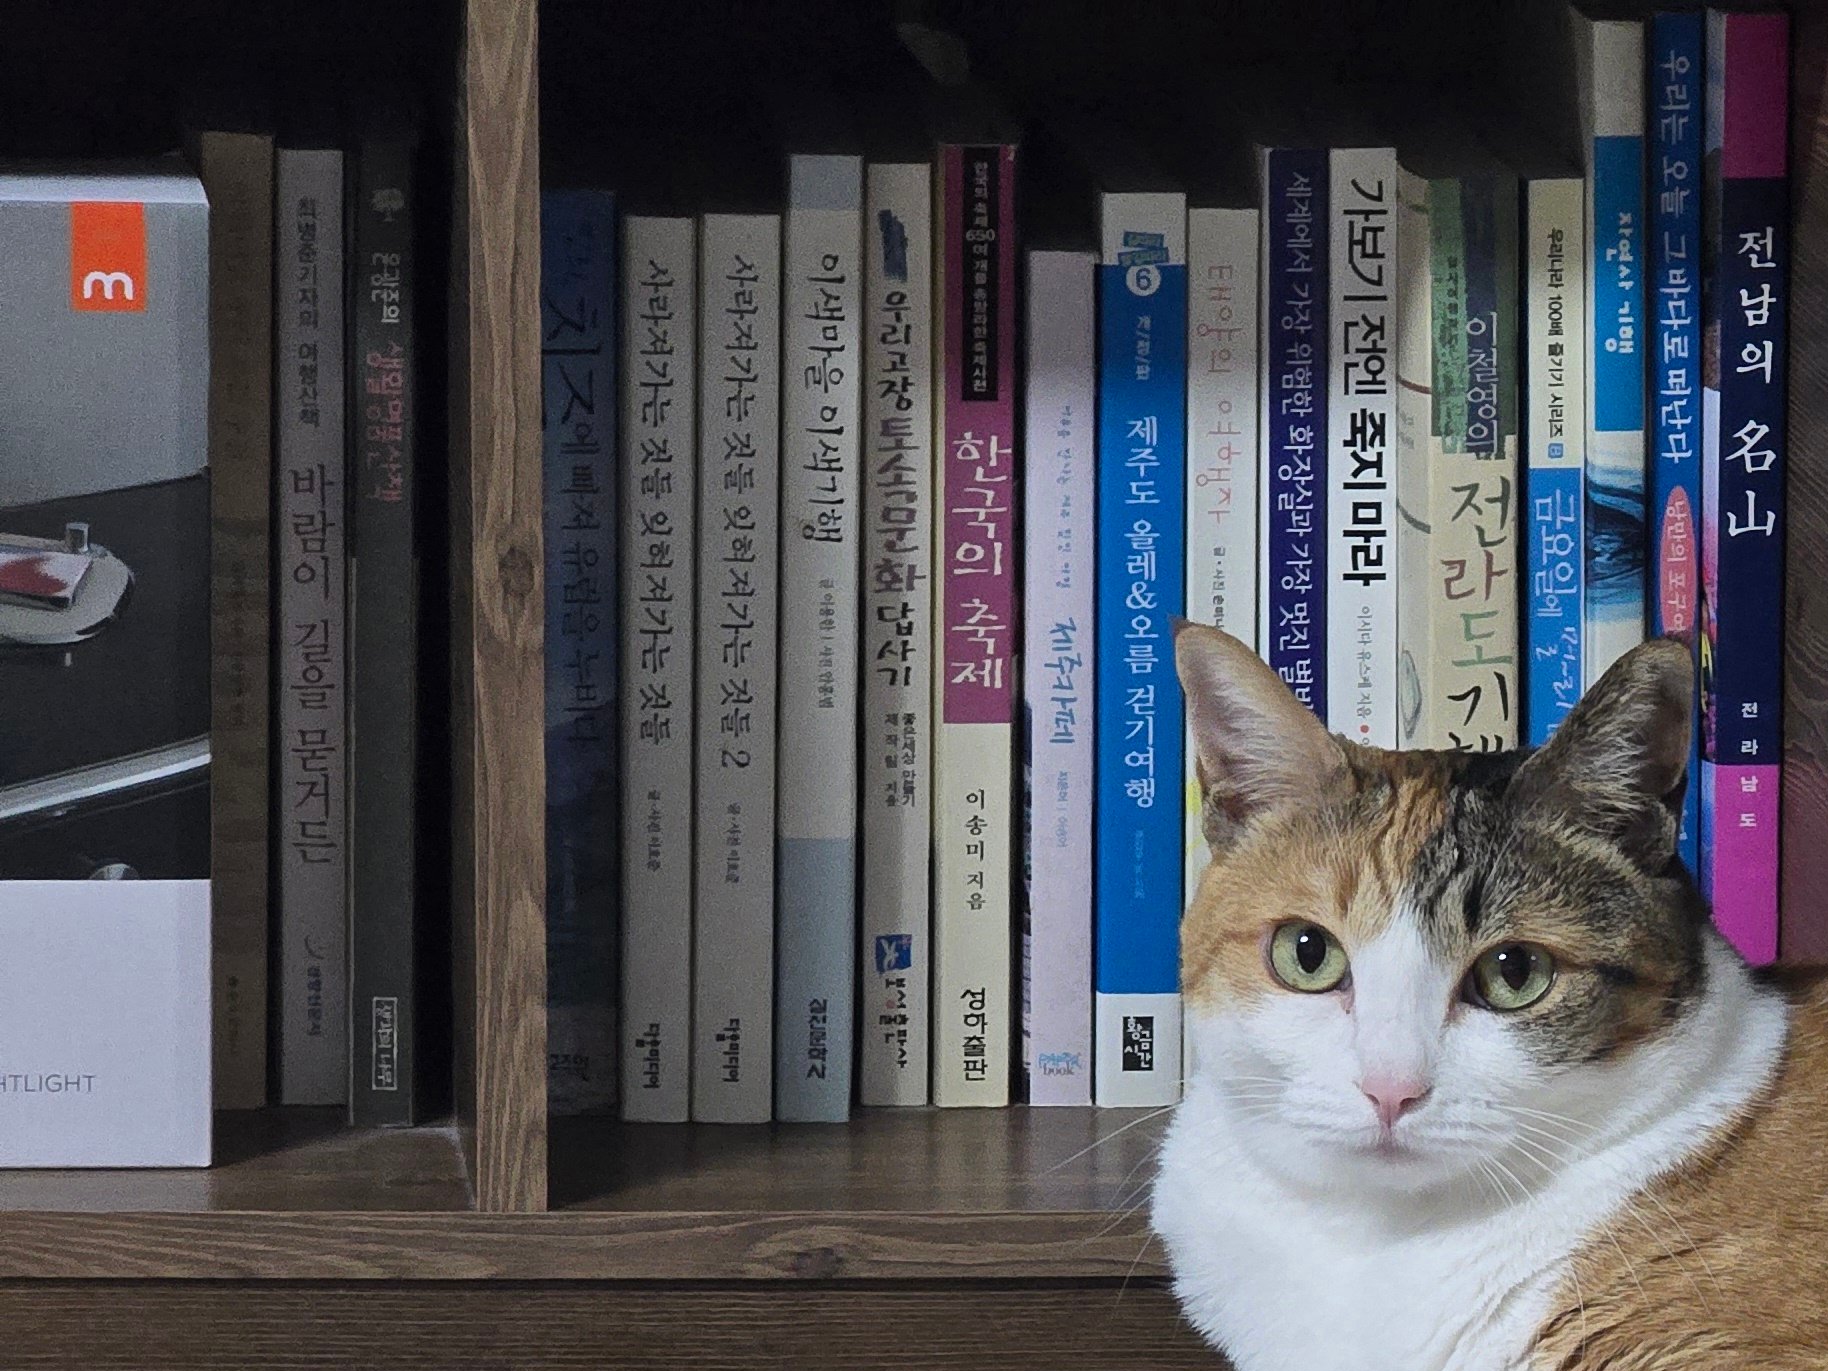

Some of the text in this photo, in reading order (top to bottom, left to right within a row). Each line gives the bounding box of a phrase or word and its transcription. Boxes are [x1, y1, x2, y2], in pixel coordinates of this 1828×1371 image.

[1659, 51, 1691, 145] 우리는
[1282, 171, 1313, 271] 세계에서
[1660, 155, 1689, 217] 오늘
[1136, 267, 1151, 291] 6
[1280, 283, 1312, 331] 가장
[1548, 228, 1564, 438] 우리나라 100배 즐기기 시리즈
[1604, 212, 1633, 353] 자연사 기행
[802, 254, 845, 543] 이색마을 이색기행
[1195, 263, 1242, 524] 태양의 여행자
[1280, 342, 1312, 415] 위험한
[1341, 178, 1387, 587] 가보기 전엔 죽지 마라
[1466, 312, 1500, 456] 이철영의
[1726, 225, 1777, 537] 전남의 名山
[639, 259, 675, 744] 사라져가는 것들 잊혀져가는 것들
[719, 254, 757, 768] 사라져가는 것들 잊혀져가는 것들 2
[1123, 416, 1161, 504] 제주도
[1277, 424, 1313, 536] 화장실과
[560, 541, 601, 639] 유럽을
[950, 433, 1012, 689] 한국의 축제
[1122, 518, 1160, 674] 올레&오름
[1278, 544, 1311, 593] 가장
[1536, 489, 1577, 617] 금요일에
[1666, 501, 1687, 632] 낭만의 포구여
[290, 463, 337, 865] 바람이 길을 묻거든
[1045, 617, 1084, 745] 제주카페
[1277, 602, 1311, 650] 멋진
[1356, 606, 1373, 718] 이시다 유스케 지음
[965, 871, 986, 911] 지음
